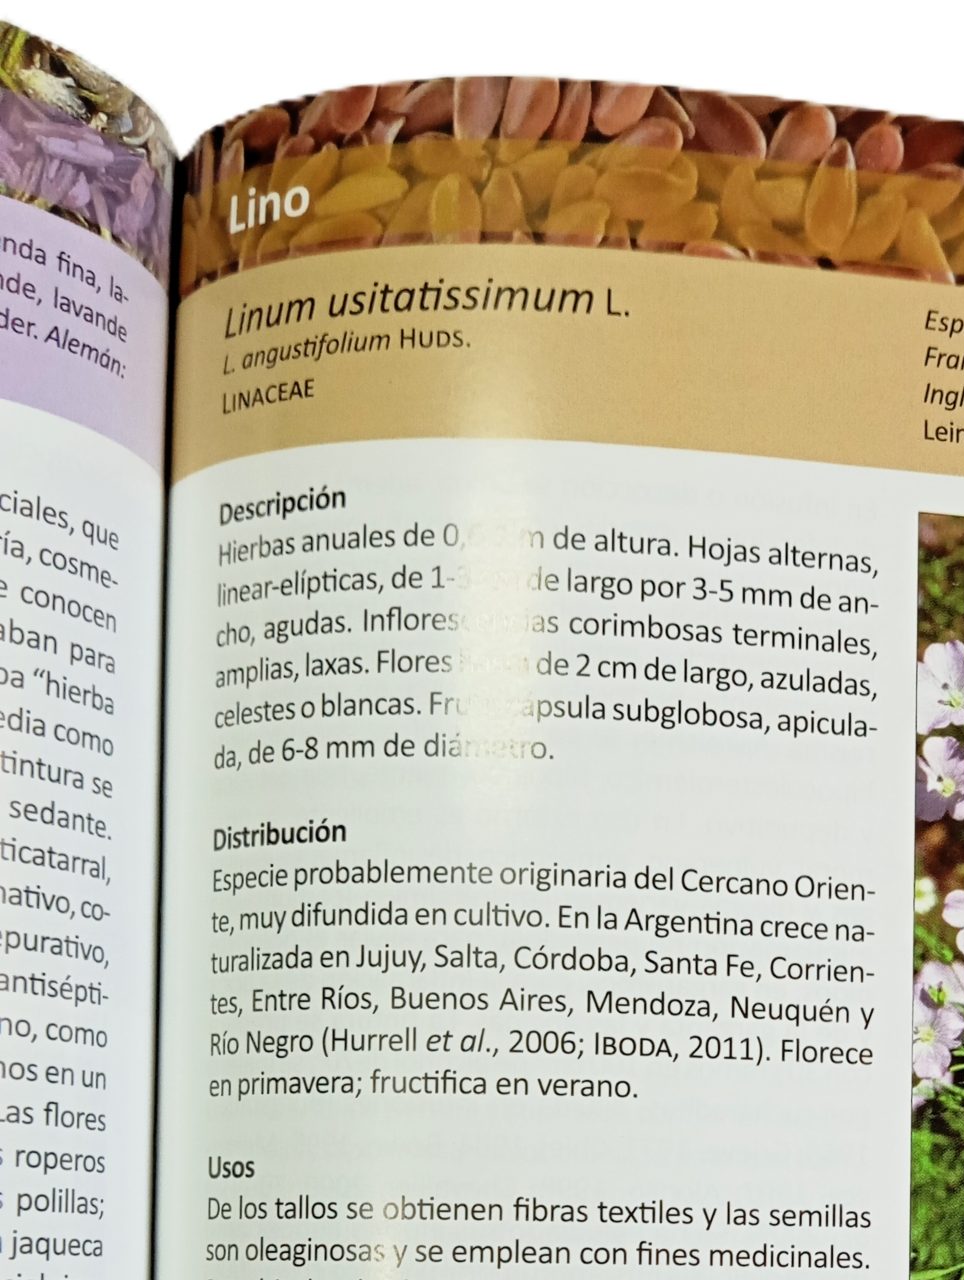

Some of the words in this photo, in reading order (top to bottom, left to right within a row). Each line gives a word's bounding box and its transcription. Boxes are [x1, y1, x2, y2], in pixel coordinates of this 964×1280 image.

[229, 184, 310, 235] Lino
[0, 236, 46, 266] nda
[56, 251, 101, 294] fina,
[109, 275, 129, 304] la-
[225, 297, 315, 340] Linum
[328, 277, 594, 319] usitatissimum
[607, 287, 629, 317] L.
[223, 354, 235, 376] L.
[242, 330, 390, 370] angustifolium
[400, 327, 470, 349] HUDS.
[223, 378, 314, 415] LINACEAE
[219, 484, 346, 526] Descripción
[82, 520, 119, 551] que
[92, 777, 113, 798] se
[9, 800, 111, 840] sedante.
[213, 818, 347, 852] Distribución
[213, 863, 288, 896] Especie
[294, 858, 493, 892] probablemente
[500, 861, 626, 892] originaria
[634, 865, 673, 891] del
[681, 868, 788, 897] Cercano
[795, 875, 876, 902] Orien-
[211, 944, 313, 974] turalizada
[320, 950, 350, 968] en
[356, 944, 426, 974] Jujuy,
[434, 943, 505, 974] Salta,
[514, 945, 636, 978] Córdoba,
[644, 950, 717, 976] Santa
[726, 953, 762, 983] Fe,
[770, 956, 875, 983] Corrien-
[211, 1030, 239, 1056] Río
[246, 1030, 314, 1059] Negro
[322, 1026, 417, 1058] (Hurrell
[426, 1030, 454, 1052] et
[460, 1027, 499, 1058] al.,
[509, 1030, 584, 1060] 2006;
[595, 1032, 679, 1063] IBODA,
[689, 1035, 770, 1066] 2011).
[781, 1038, 873, 1065] Florece
[209, 1078, 231, 1097] en
[238, 1070, 362, 1102] primavera;
[370, 1068, 487, 1095] fructifica
[496, 1077, 528, 1095] en
[537, 1078, 638, 1098] verano.
[208, 1156, 255, 1179] Usos
